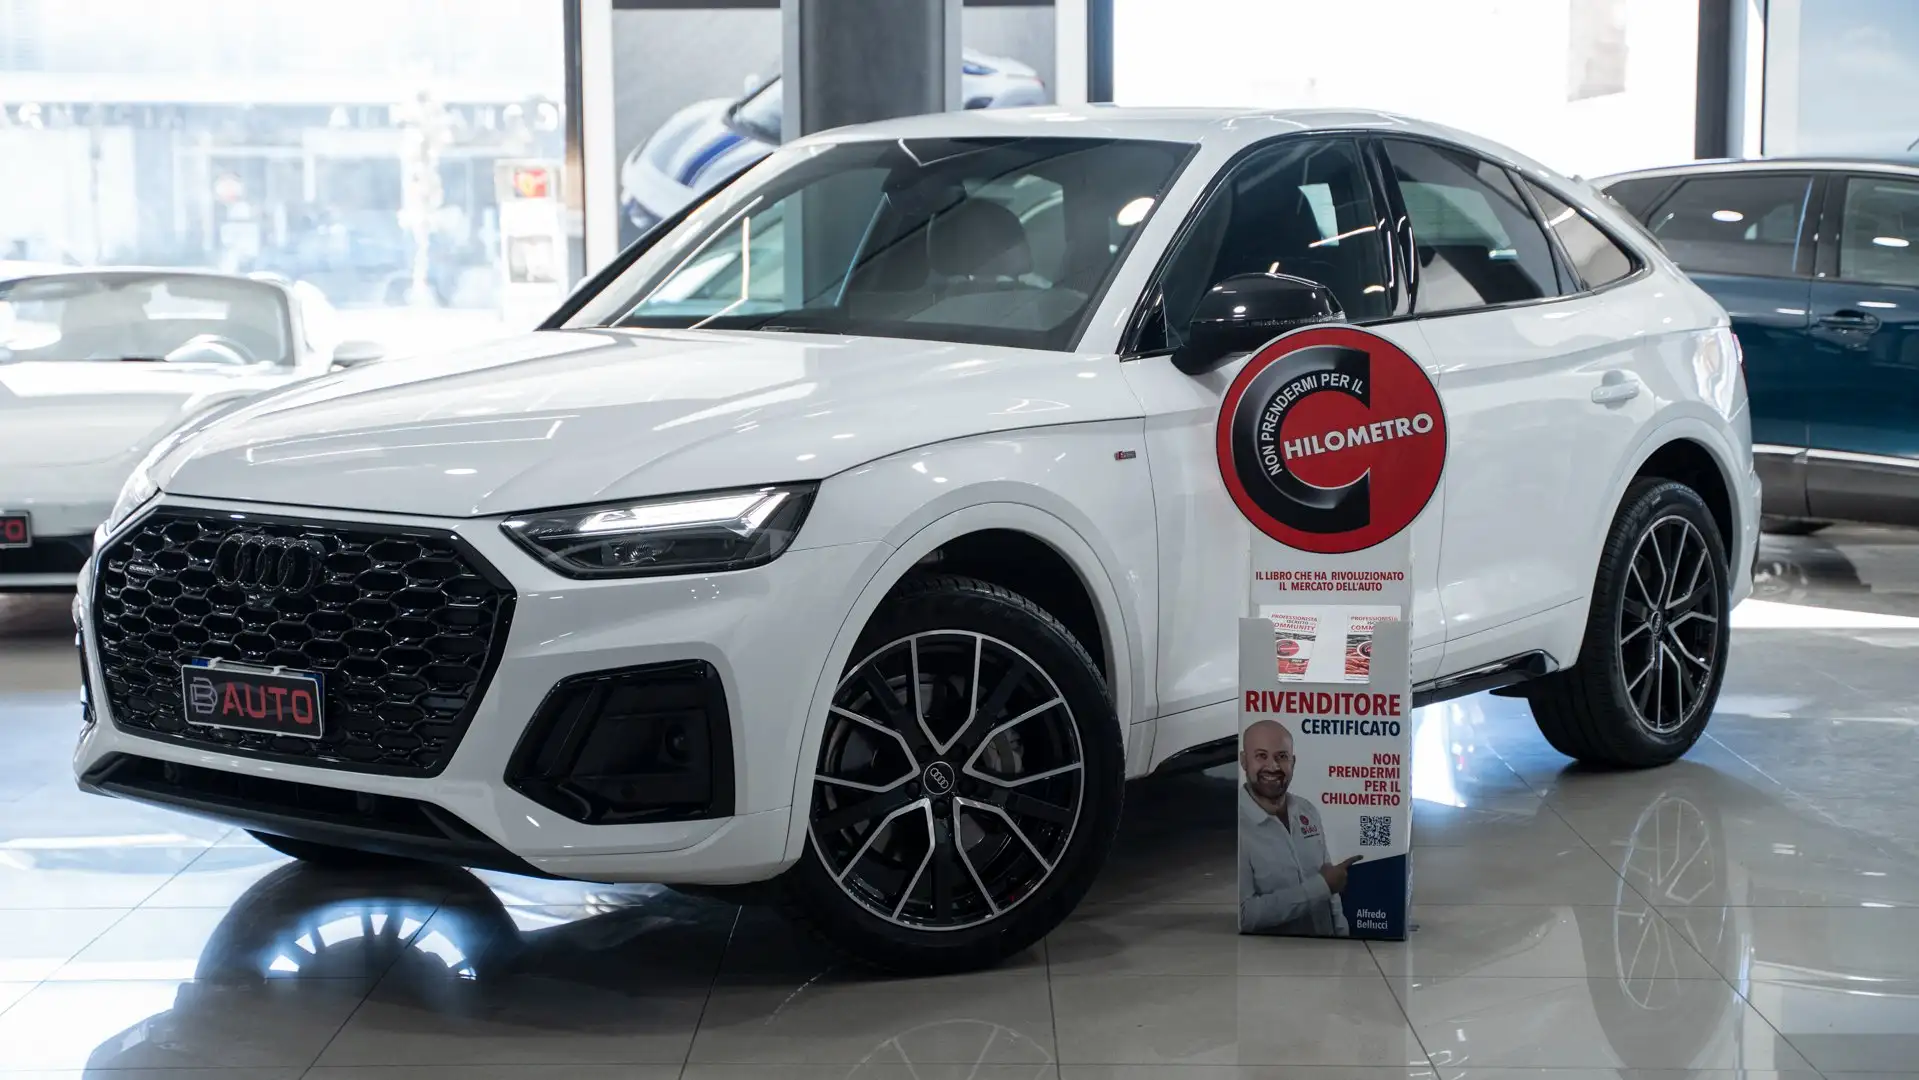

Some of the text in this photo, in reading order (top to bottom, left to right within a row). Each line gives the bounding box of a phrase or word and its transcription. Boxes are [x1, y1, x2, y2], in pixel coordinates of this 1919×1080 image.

[1262, 373, 1364, 477] NON PRENDERMI PER IL
[1255, 571, 1404, 581] IL LIBRO CHE HA RIVOLUZIONATO
[1279, 582, 1383, 591] IL MERCATO DELL'AUTO
[1273, 622, 1316, 631] OMMUNITY
[1245, 690, 1401, 717] RIVENDITORE
[1301, 718, 1401, 737] CERTIFICATO
[1373, 753, 1400, 766] NON
[1328, 765, 1400, 779] PRENDERMI
[1364, 780, 1401, 793] PER IL
[1321, 792, 1400, 806] CHILOMETRO
[1356, 908, 1387, 919] Alfredo
[1356, 919, 1388, 930] Bellucci
